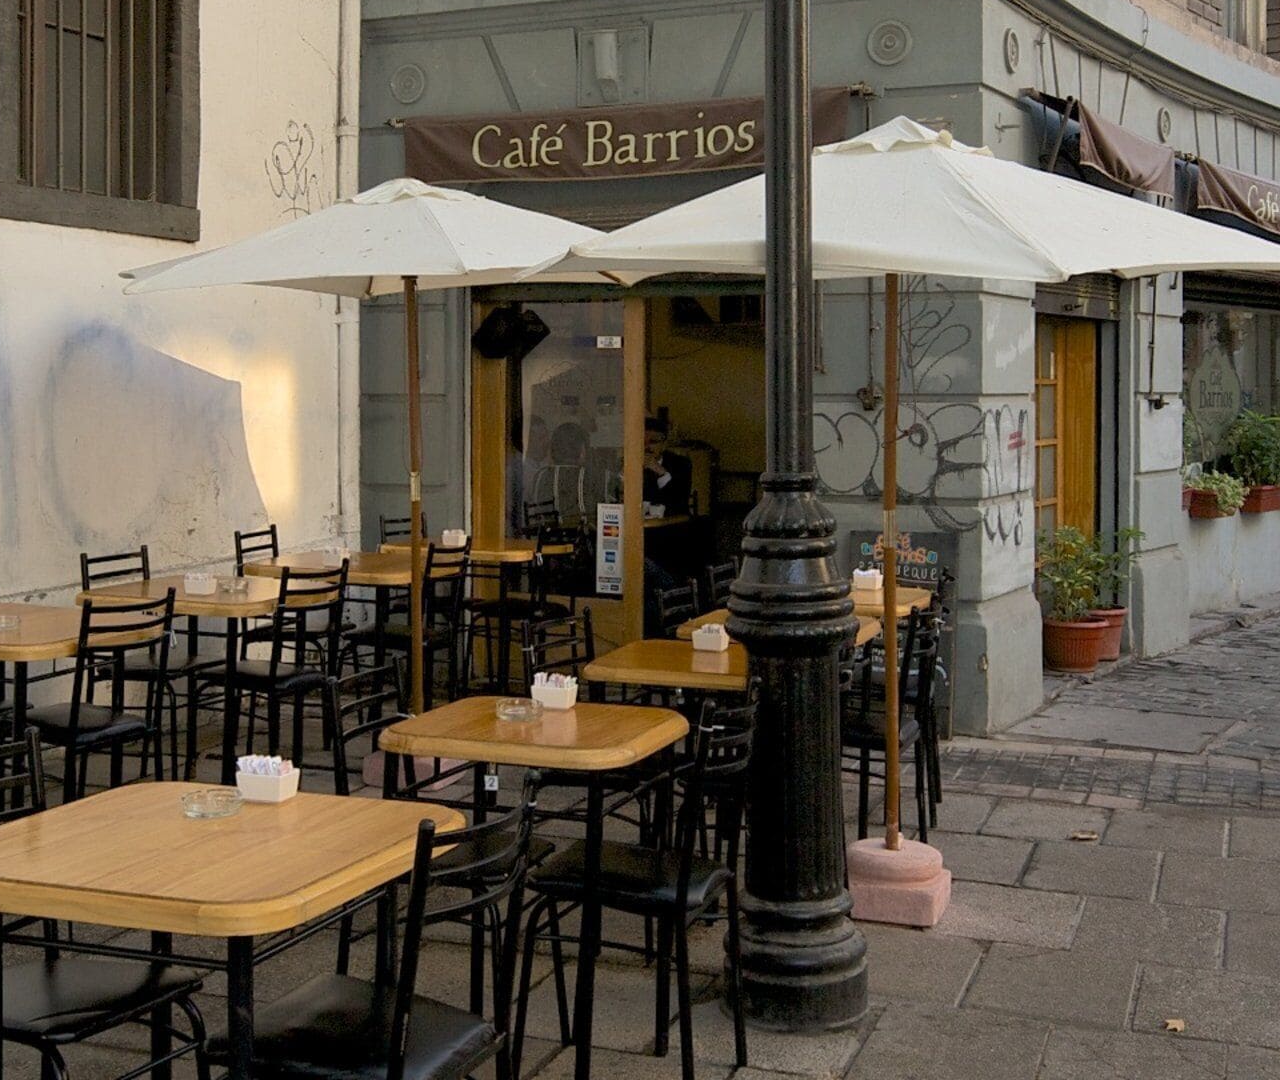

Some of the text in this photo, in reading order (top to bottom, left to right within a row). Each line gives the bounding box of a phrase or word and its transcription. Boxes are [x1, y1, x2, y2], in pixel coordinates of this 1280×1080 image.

[472, 112, 756, 168] Café Barrios
[488, 776, 495, 788] 2
